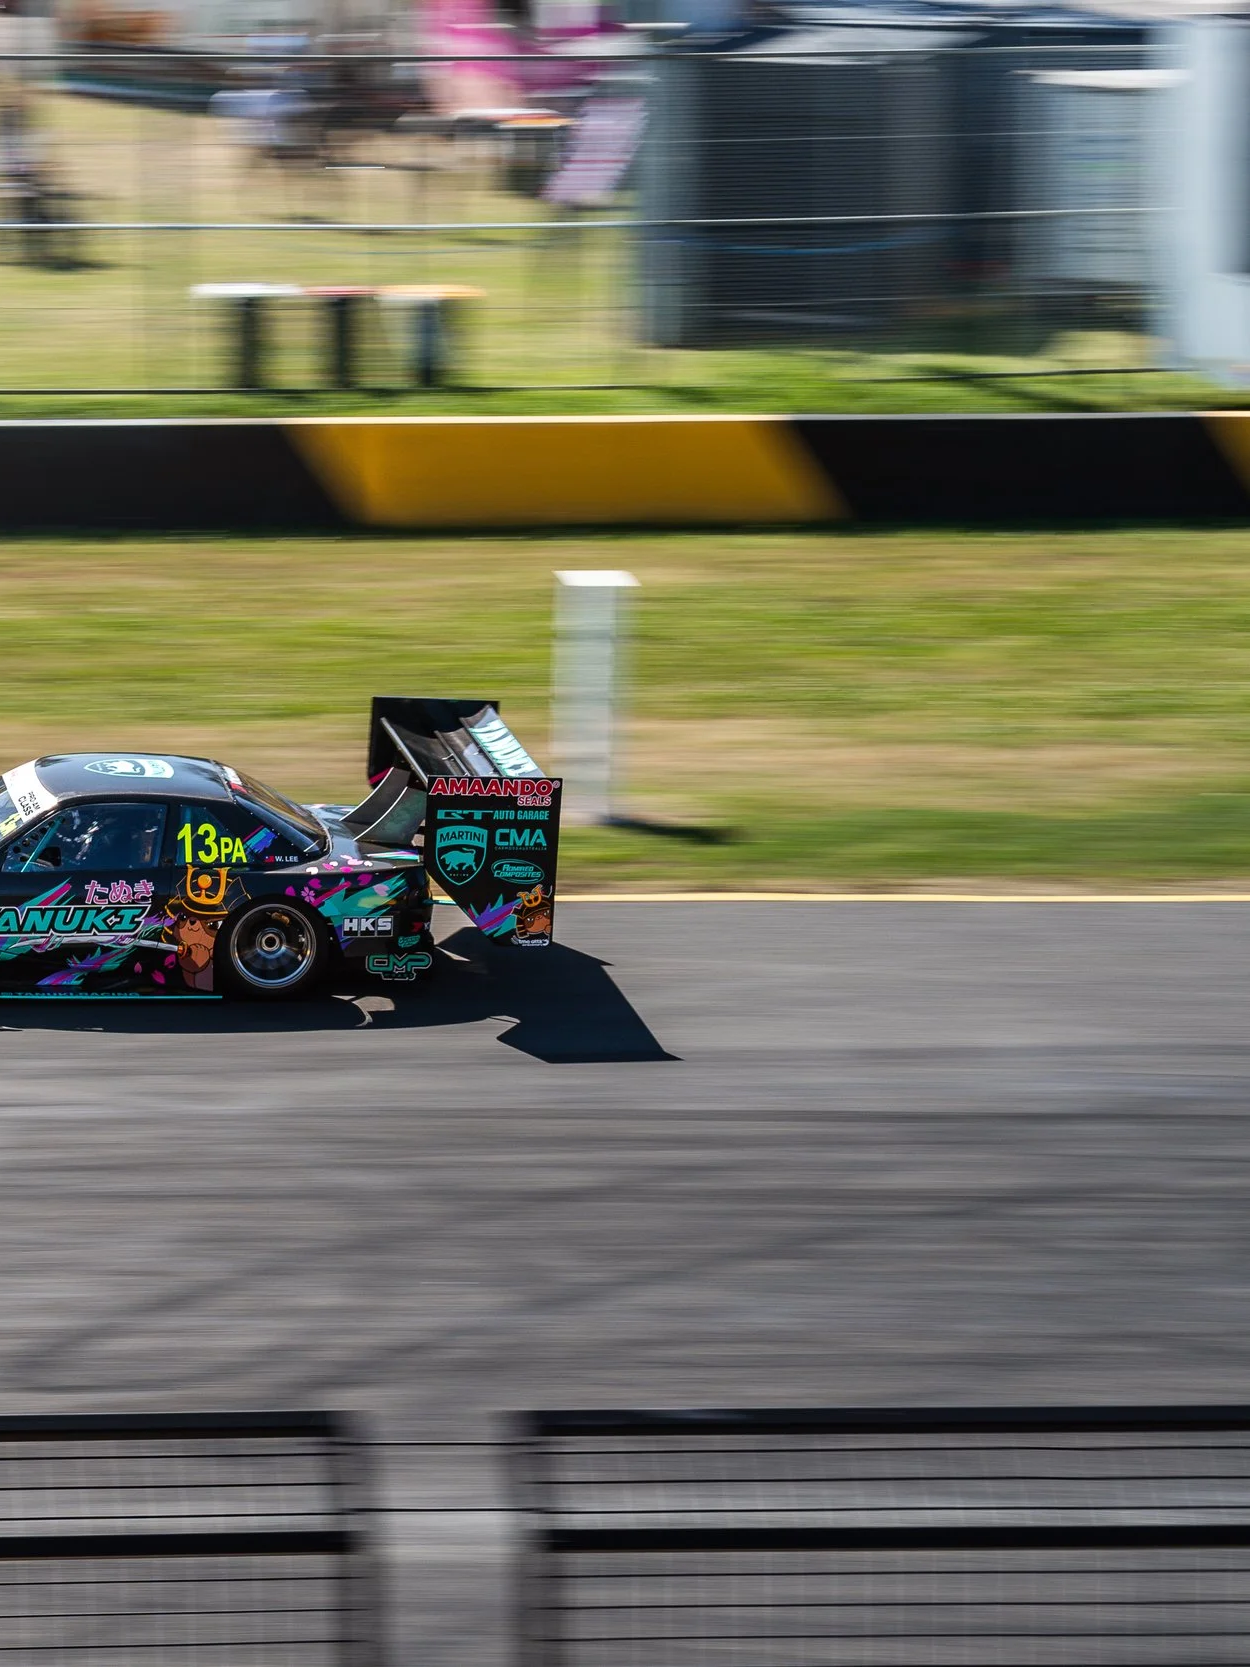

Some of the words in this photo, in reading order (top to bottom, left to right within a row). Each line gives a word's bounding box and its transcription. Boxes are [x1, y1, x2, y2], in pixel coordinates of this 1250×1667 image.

[17, 796, 34, 817] CLASS
[517, 796, 551, 807] SEALS
[493, 810, 515, 820] AUTO
[517, 810, 550, 820] GARAGE
[439, 830, 485, 843] MARTINI
[495, 828, 547, 847] CMA
[493, 870, 541, 878] COMPOSITES
[84, 879, 155, 905] たぬき
[343, 917, 392, 932] HKS
